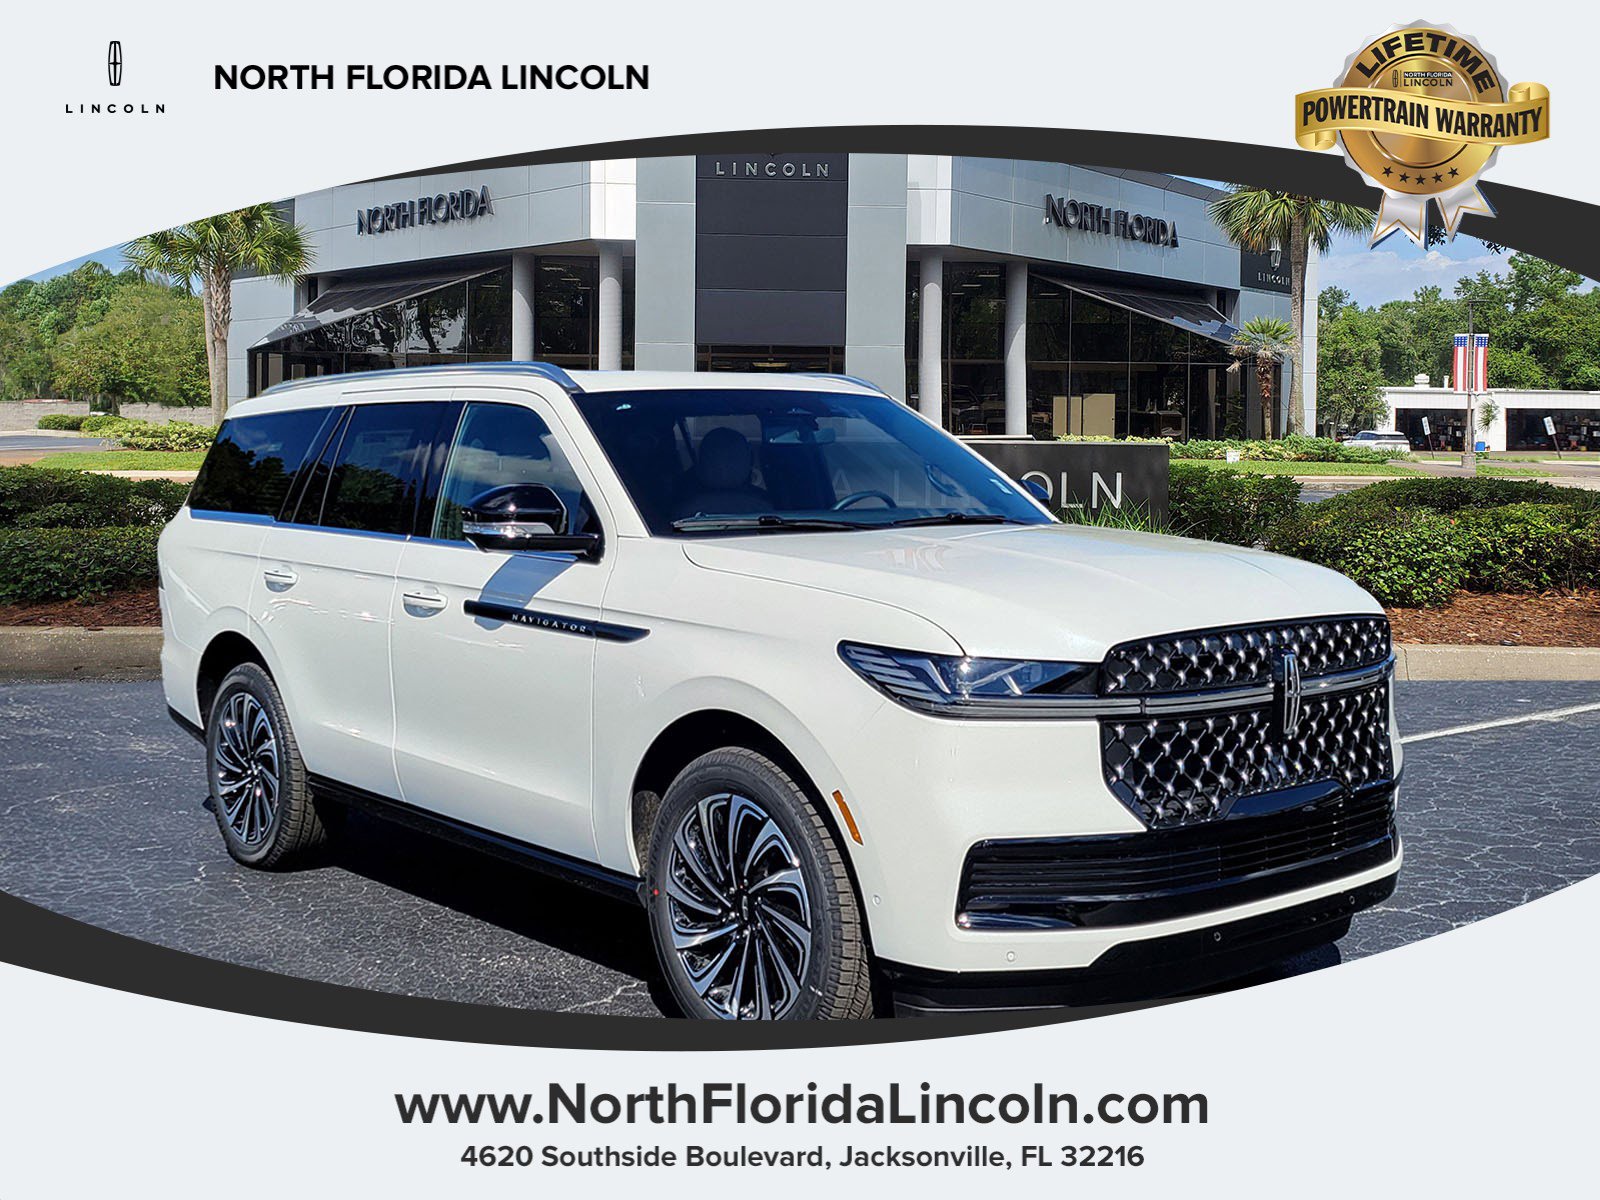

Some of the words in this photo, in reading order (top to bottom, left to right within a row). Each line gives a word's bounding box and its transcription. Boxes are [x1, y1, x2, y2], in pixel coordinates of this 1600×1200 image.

[715, 161, 829, 178] LINCOLN
[356, 201, 415, 236] NORTH
[417, 184, 495, 226] FLORIDA
[1045, 193, 1112, 236] NORTH
[1114, 209, 1179, 249] FLORIDA
[511, 612, 588, 633] NAVIGATOR
